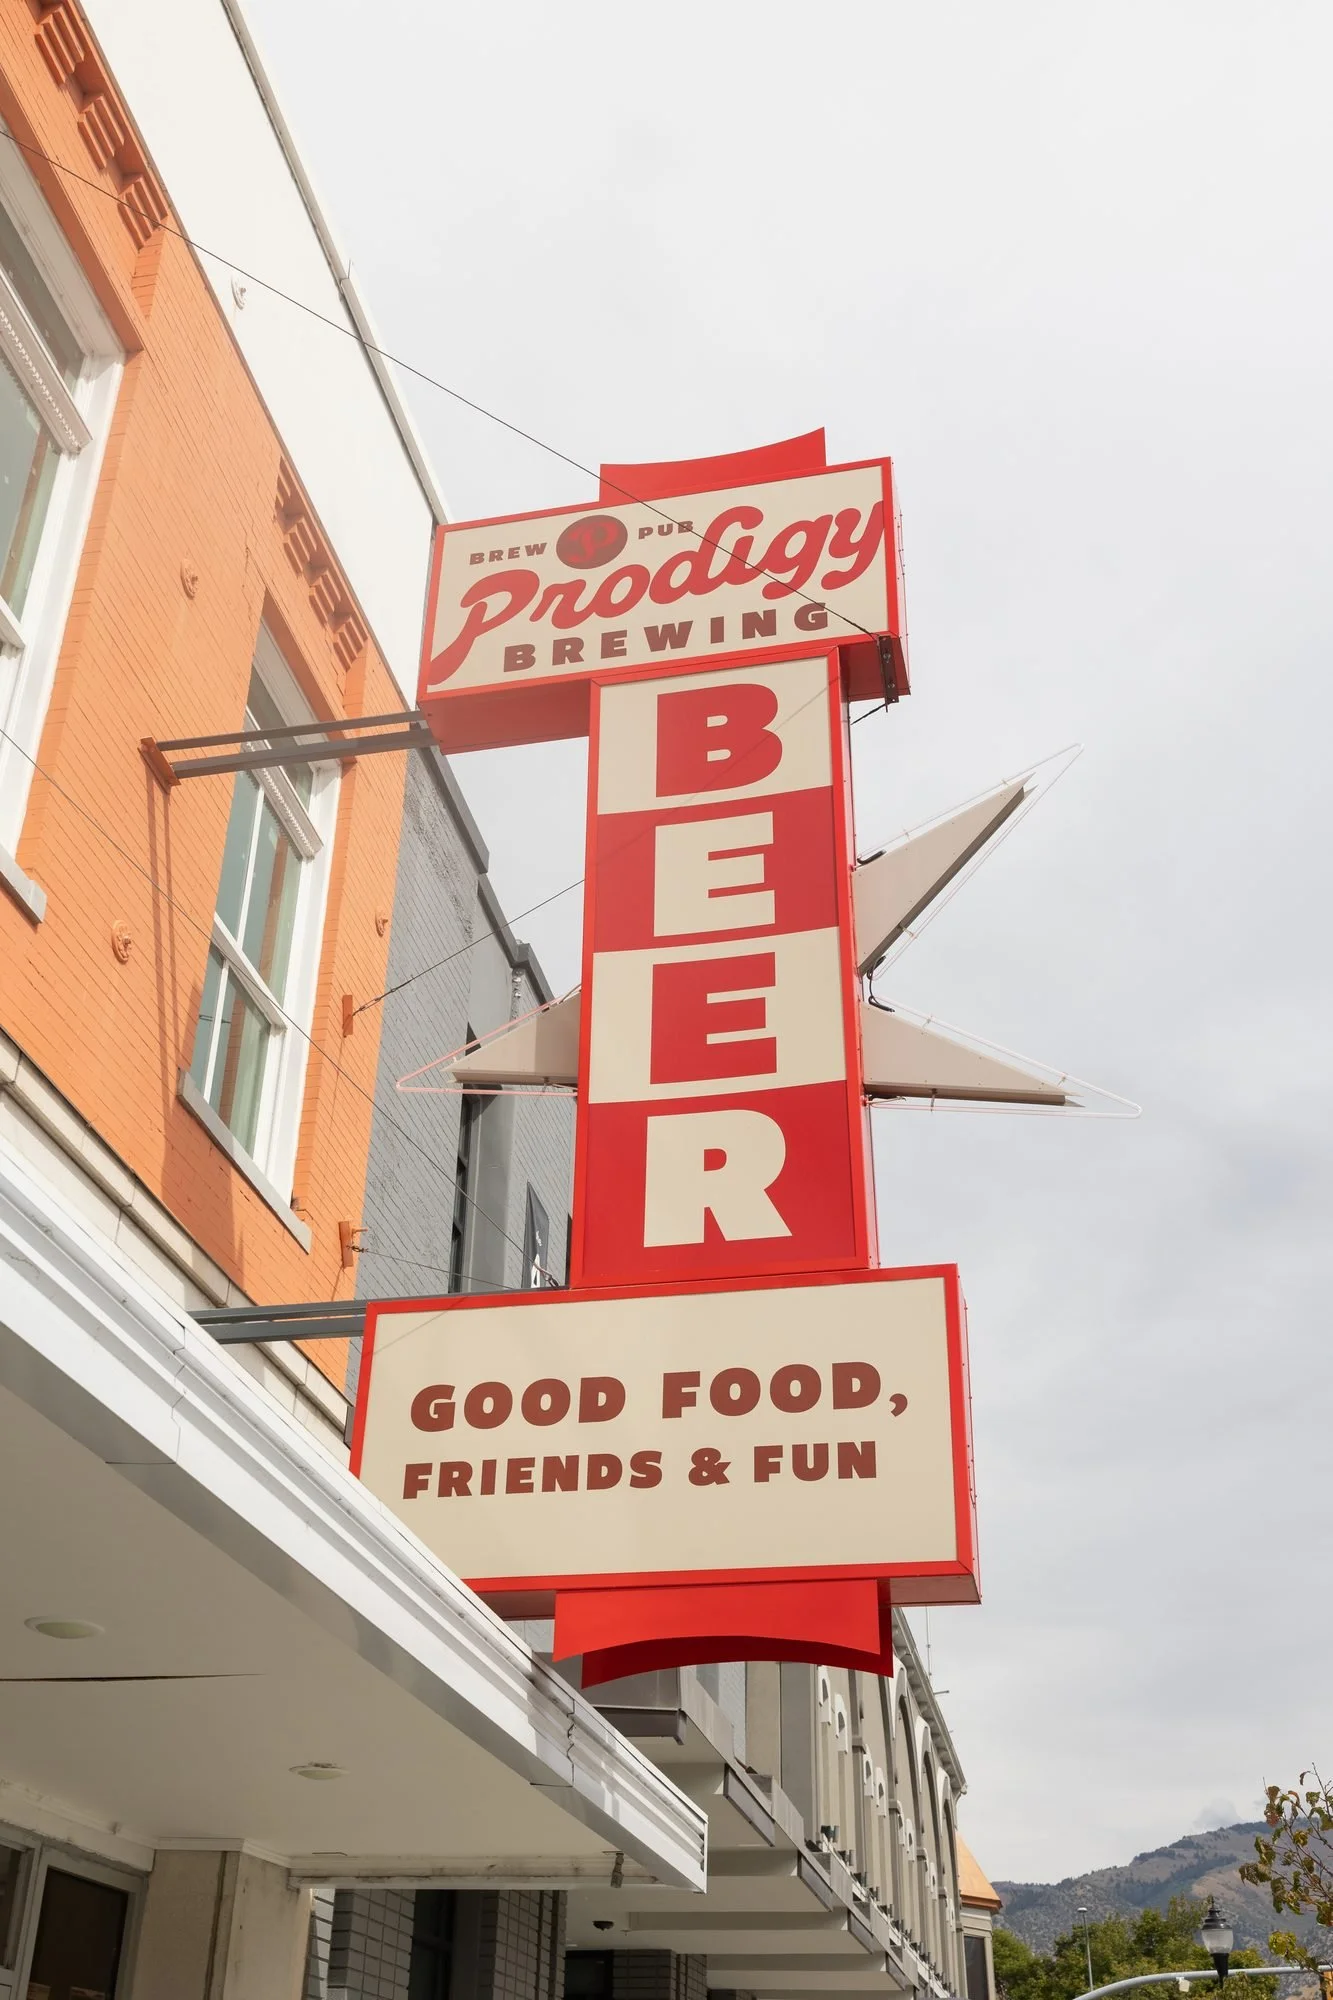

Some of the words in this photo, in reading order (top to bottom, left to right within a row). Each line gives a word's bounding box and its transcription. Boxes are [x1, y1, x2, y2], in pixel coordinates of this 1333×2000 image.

[469, 541, 547, 565] BREW
[638, 519, 694, 540] PUB
[431, 501, 884, 685] Prodigy
[503, 603, 829, 672] BREWING
[643, 683, 793, 1248] BEER
[410, 1376, 626, 1433] GOOD
[661, 1361, 909, 1419] FOOD,
[402, 1450, 663, 1500] FRIENDS
[688, 1447, 732, 1487] &
[753, 1440, 877, 1483] FUN
